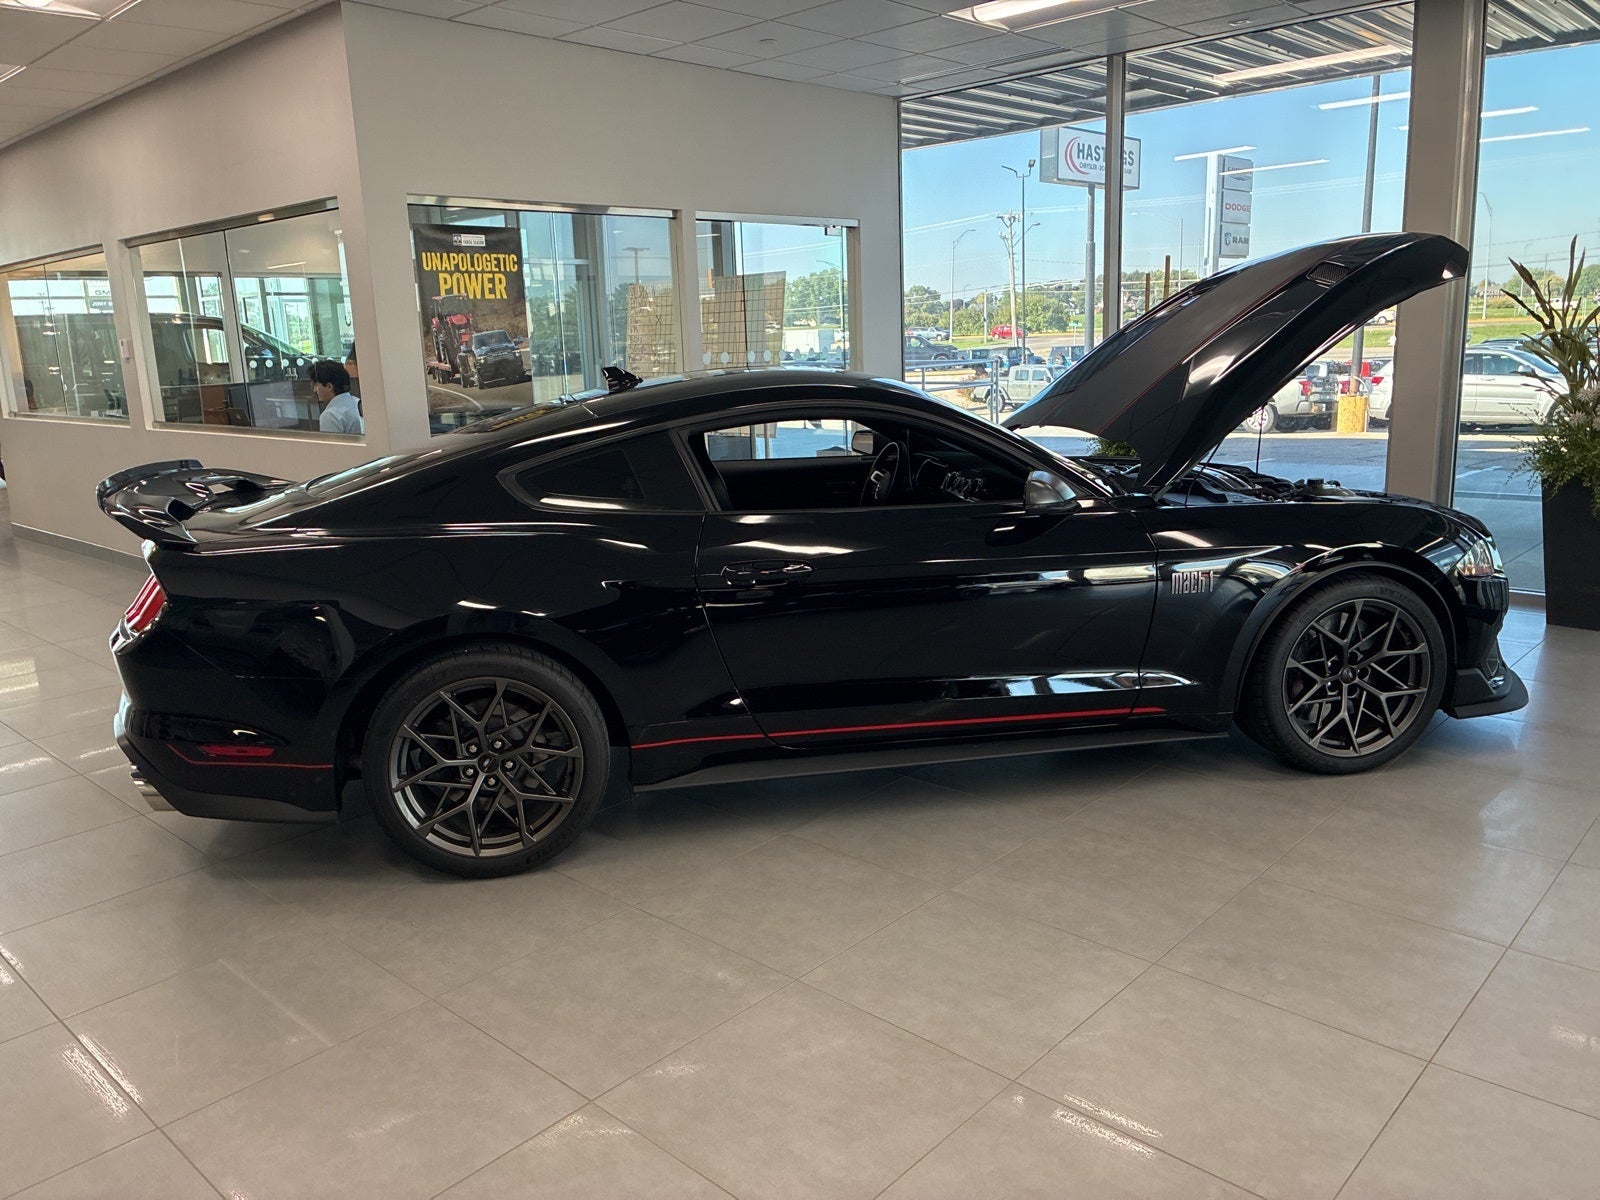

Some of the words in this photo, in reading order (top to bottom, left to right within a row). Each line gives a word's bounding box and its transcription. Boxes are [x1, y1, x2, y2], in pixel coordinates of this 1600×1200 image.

[1077, 142, 1135, 167] HASTGS
[1225, 203, 1251, 213] DODGE
[422, 252, 518, 272] UNAPOLOGETIC
[438, 272, 508, 299] POWER
